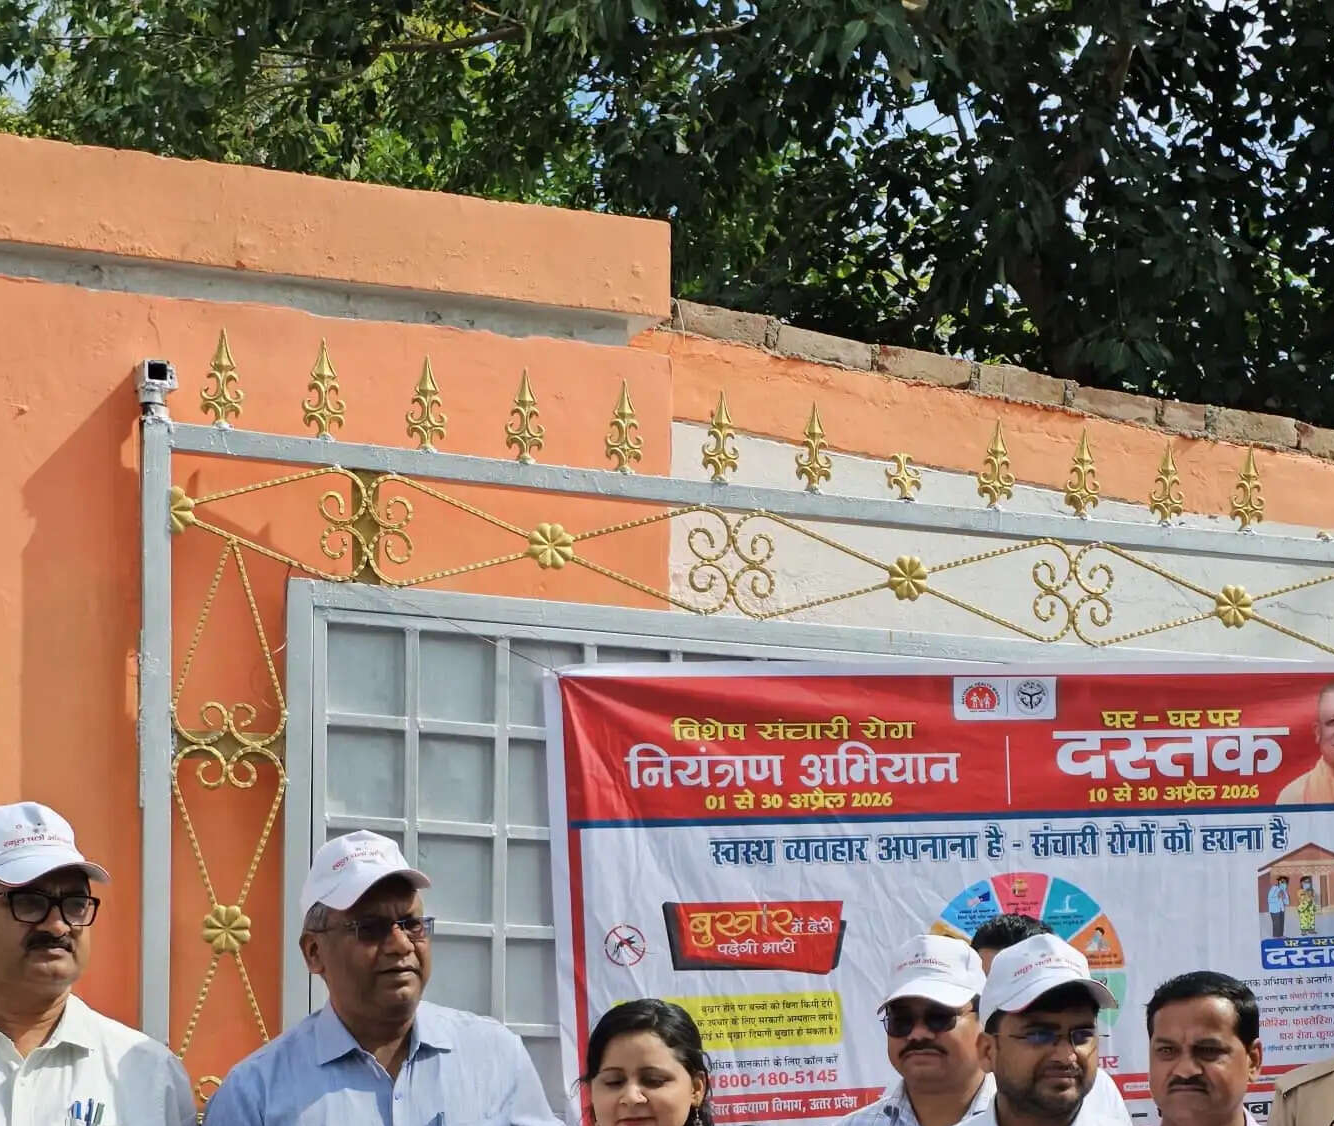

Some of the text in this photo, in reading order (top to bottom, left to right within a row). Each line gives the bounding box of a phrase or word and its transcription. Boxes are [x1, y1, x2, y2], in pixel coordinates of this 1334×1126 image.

[671, 715, 917, 742] विशेष संचारी रोग
[1101, 709, 1243, 729] घर घर पर
[624, 740, 962, 789] नियंत्रण अभियान
[1052, 727, 1291, 781] दस्तक
[705, 786, 893, 812] 01 से 30 अप्रैल 2026
[1088, 780, 1260, 803] 10 से 30 अप्रैल 2026
[709, 816, 1291, 867] स्वस्थ व्यवहार अपनाना है संचारी रोगों को हराना है
[689, 904, 835, 948] बुखार में देरी
[717, 938, 797, 957] पड़ेगी भारी
[736, 1057, 770, 1069] जानकारी
[773, 1056, 782, 1067] के
[784, 1055, 802, 1067] लिए
[804, 1054, 823, 1066] कॉल
[710, 1069, 838, 1089] 1800-180-5145
[733, 1093, 858, 1115] कल्याण विभाग, उत्तर प्रदेश
